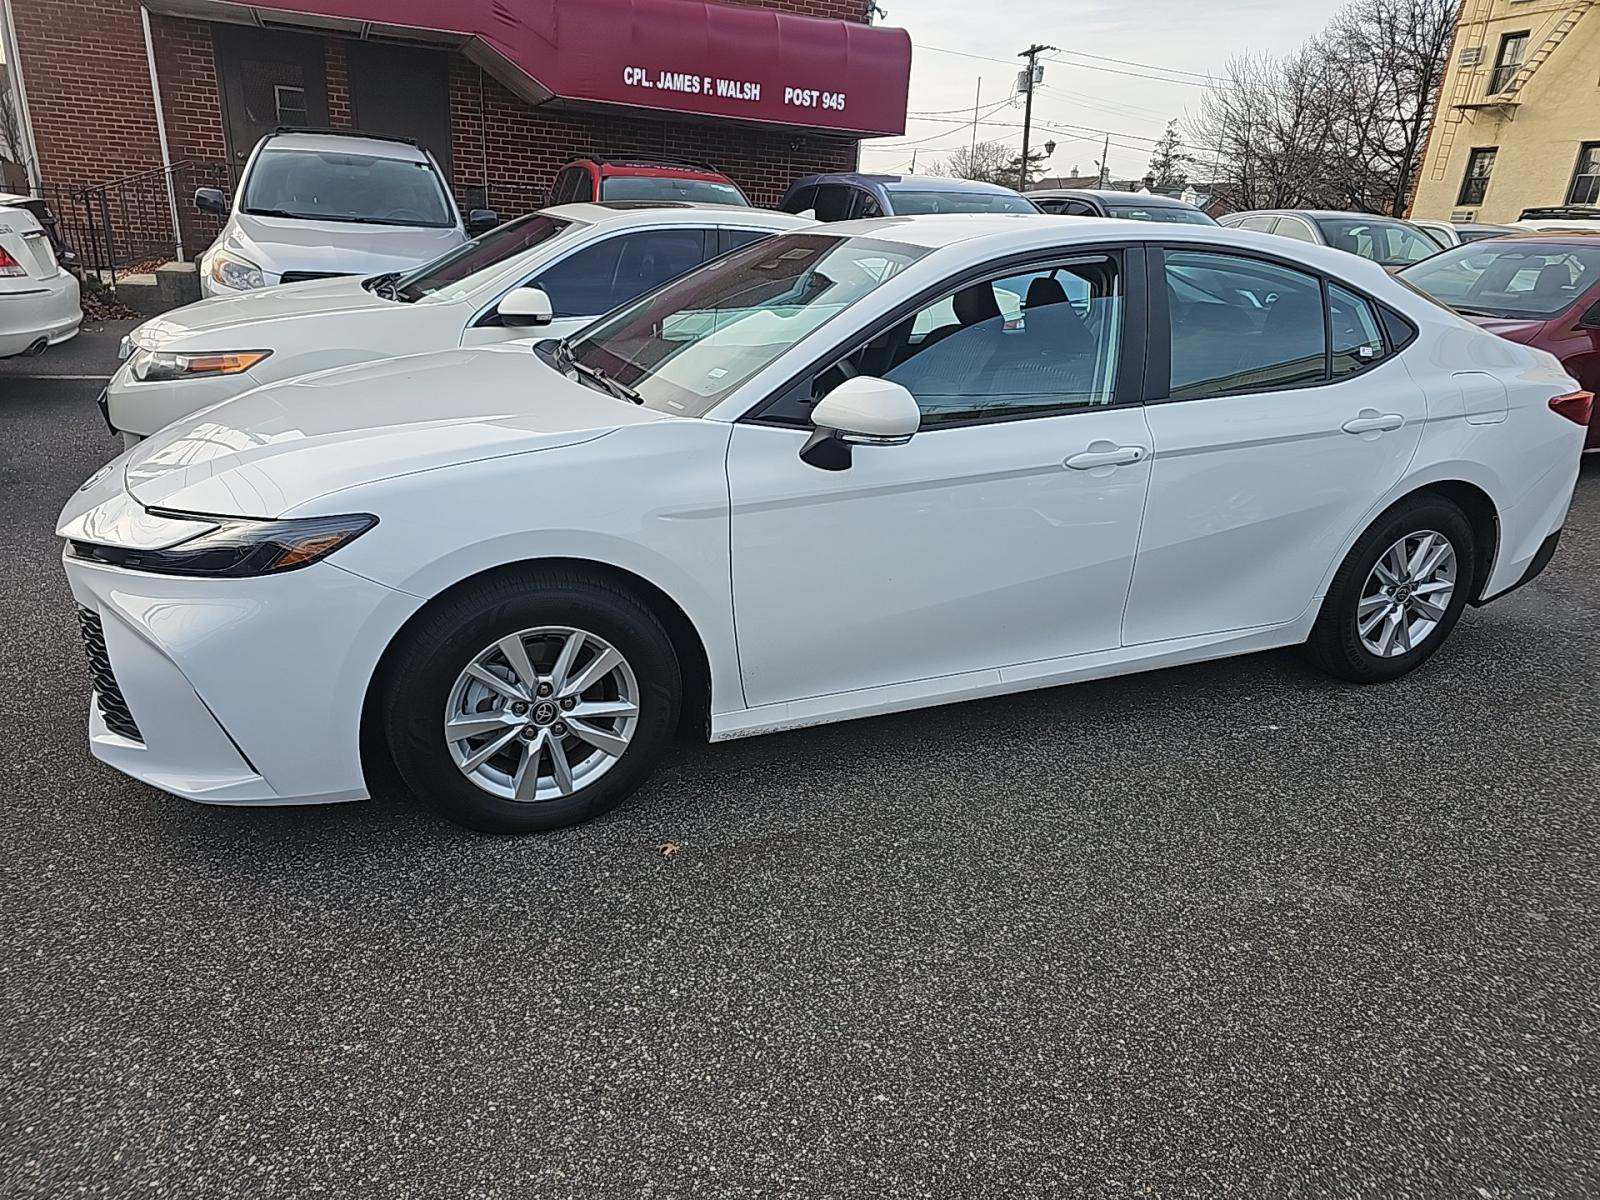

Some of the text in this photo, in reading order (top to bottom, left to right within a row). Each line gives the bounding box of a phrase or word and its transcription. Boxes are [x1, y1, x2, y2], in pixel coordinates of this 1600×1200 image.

[623, 66, 846, 110] CPL. JAMES F. WALSH POST 945
